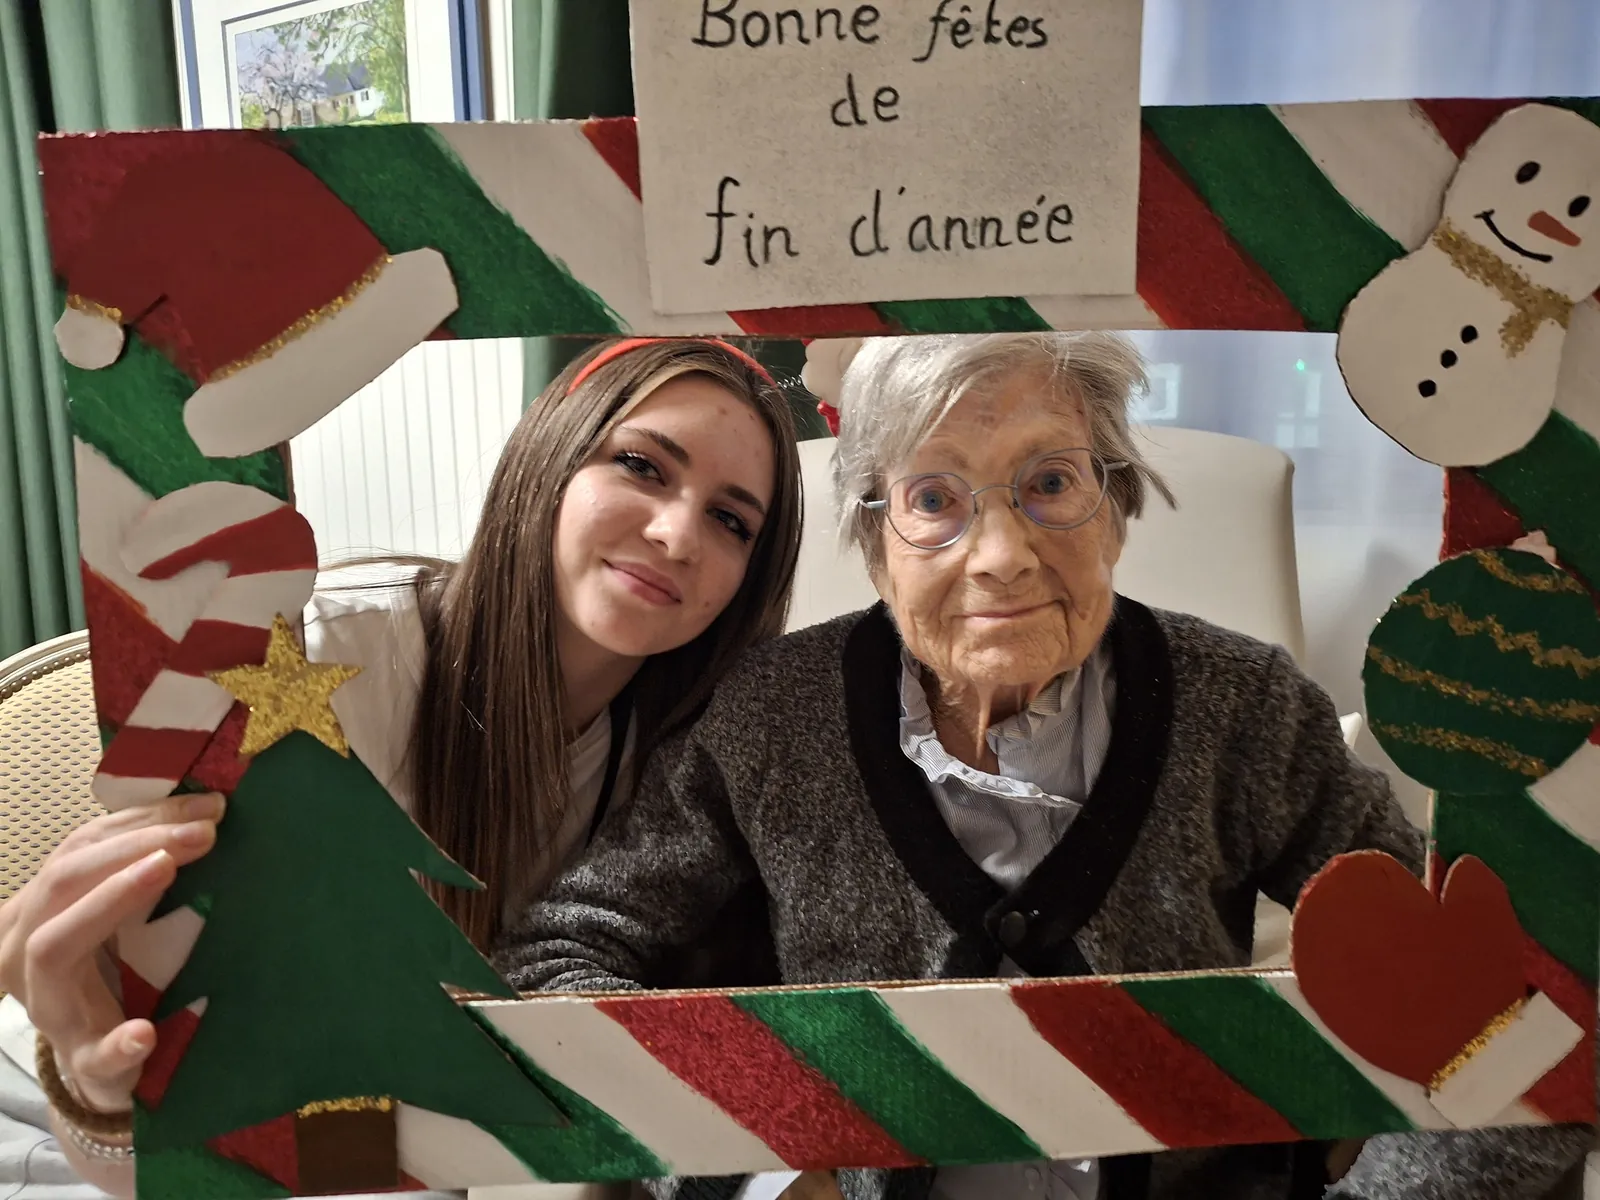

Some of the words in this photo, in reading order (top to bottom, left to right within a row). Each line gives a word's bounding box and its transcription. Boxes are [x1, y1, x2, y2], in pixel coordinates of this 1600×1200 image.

[691, 0, 880, 48] Bonne
[912, 0, 1049, 63] fêtes
[830, 72, 900, 128] de
[703, 175, 800, 269] fin
[849, 187, 1075, 258] d'année
